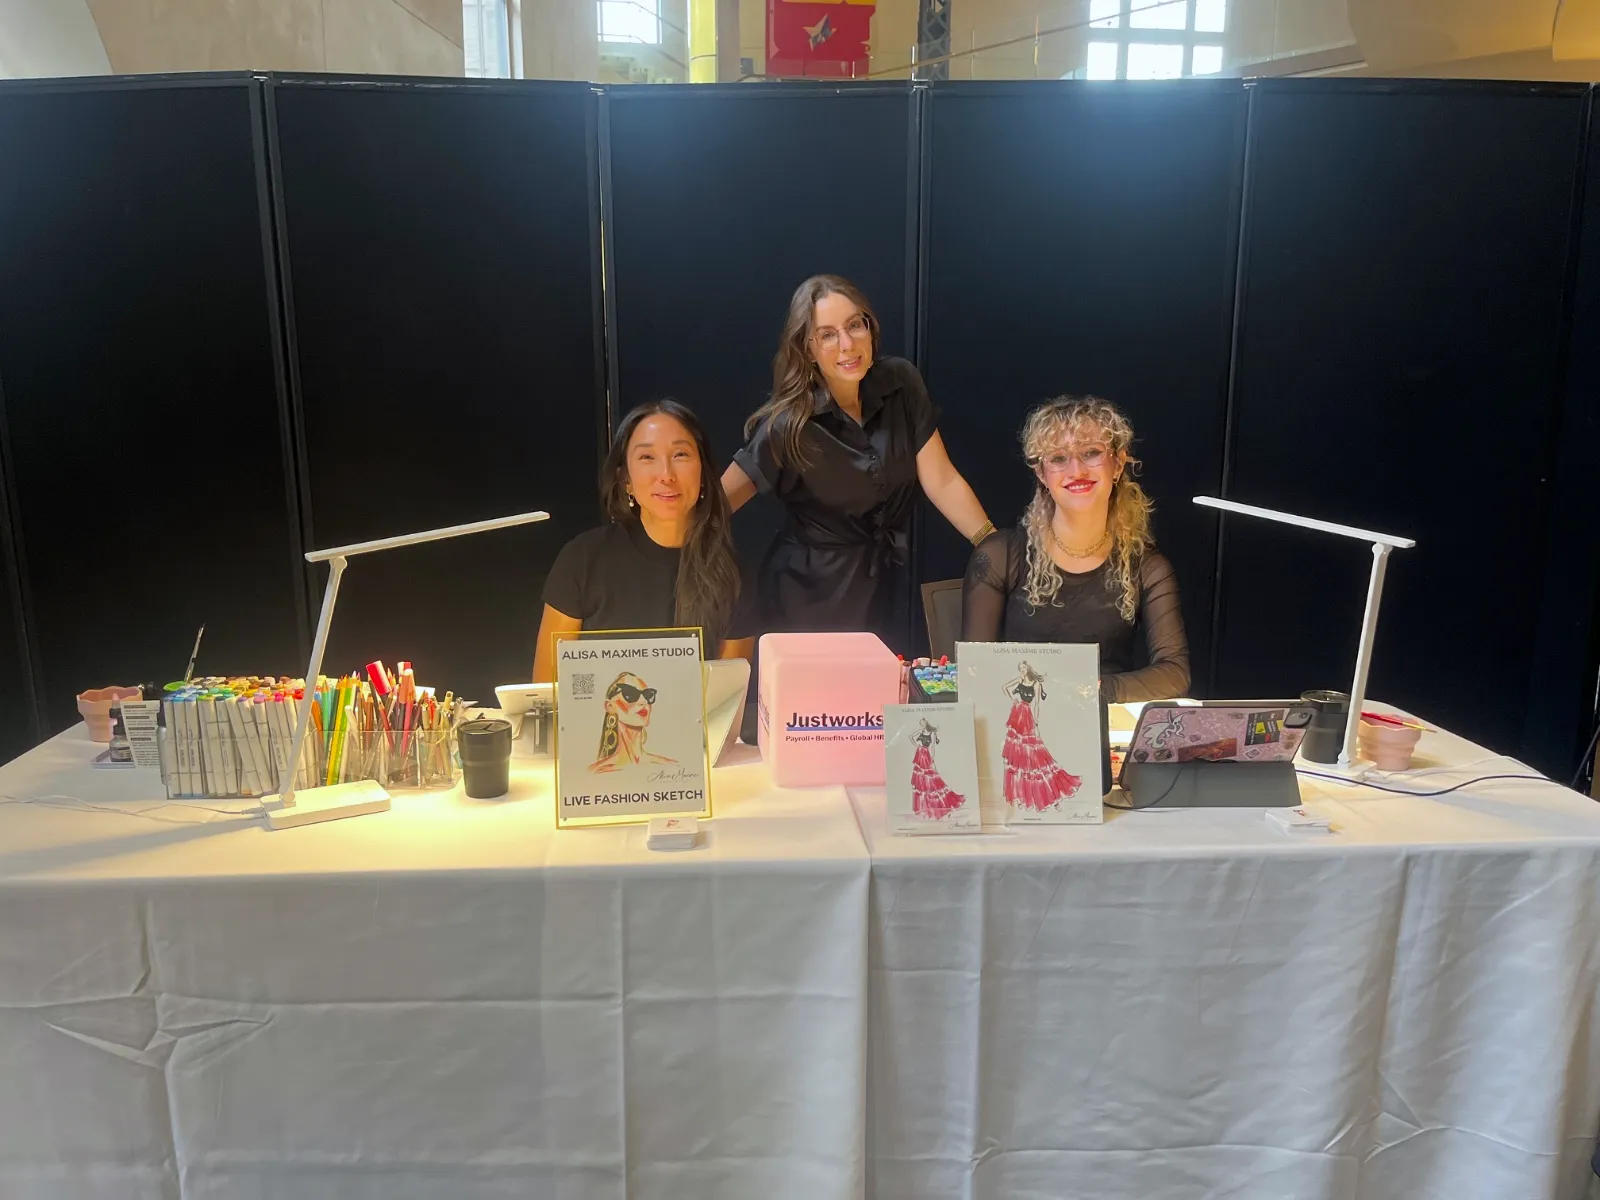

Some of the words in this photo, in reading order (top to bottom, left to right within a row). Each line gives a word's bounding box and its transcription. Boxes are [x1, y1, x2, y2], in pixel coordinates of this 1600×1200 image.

[562, 650, 598, 660] ALISA
[601, 648, 649, 659] MAXIME
[652, 647, 695, 657] STUDIO
[786, 711, 884, 728] Justworks
[785, 735, 810, 743] Payroll
[815, 734, 845, 742] Benefits
[849, 733, 873, 741] Global
[564, 795, 591, 807] LIVE
[594, 792, 650, 805] FASHION
[653, 789, 703, 802] SKETCH
